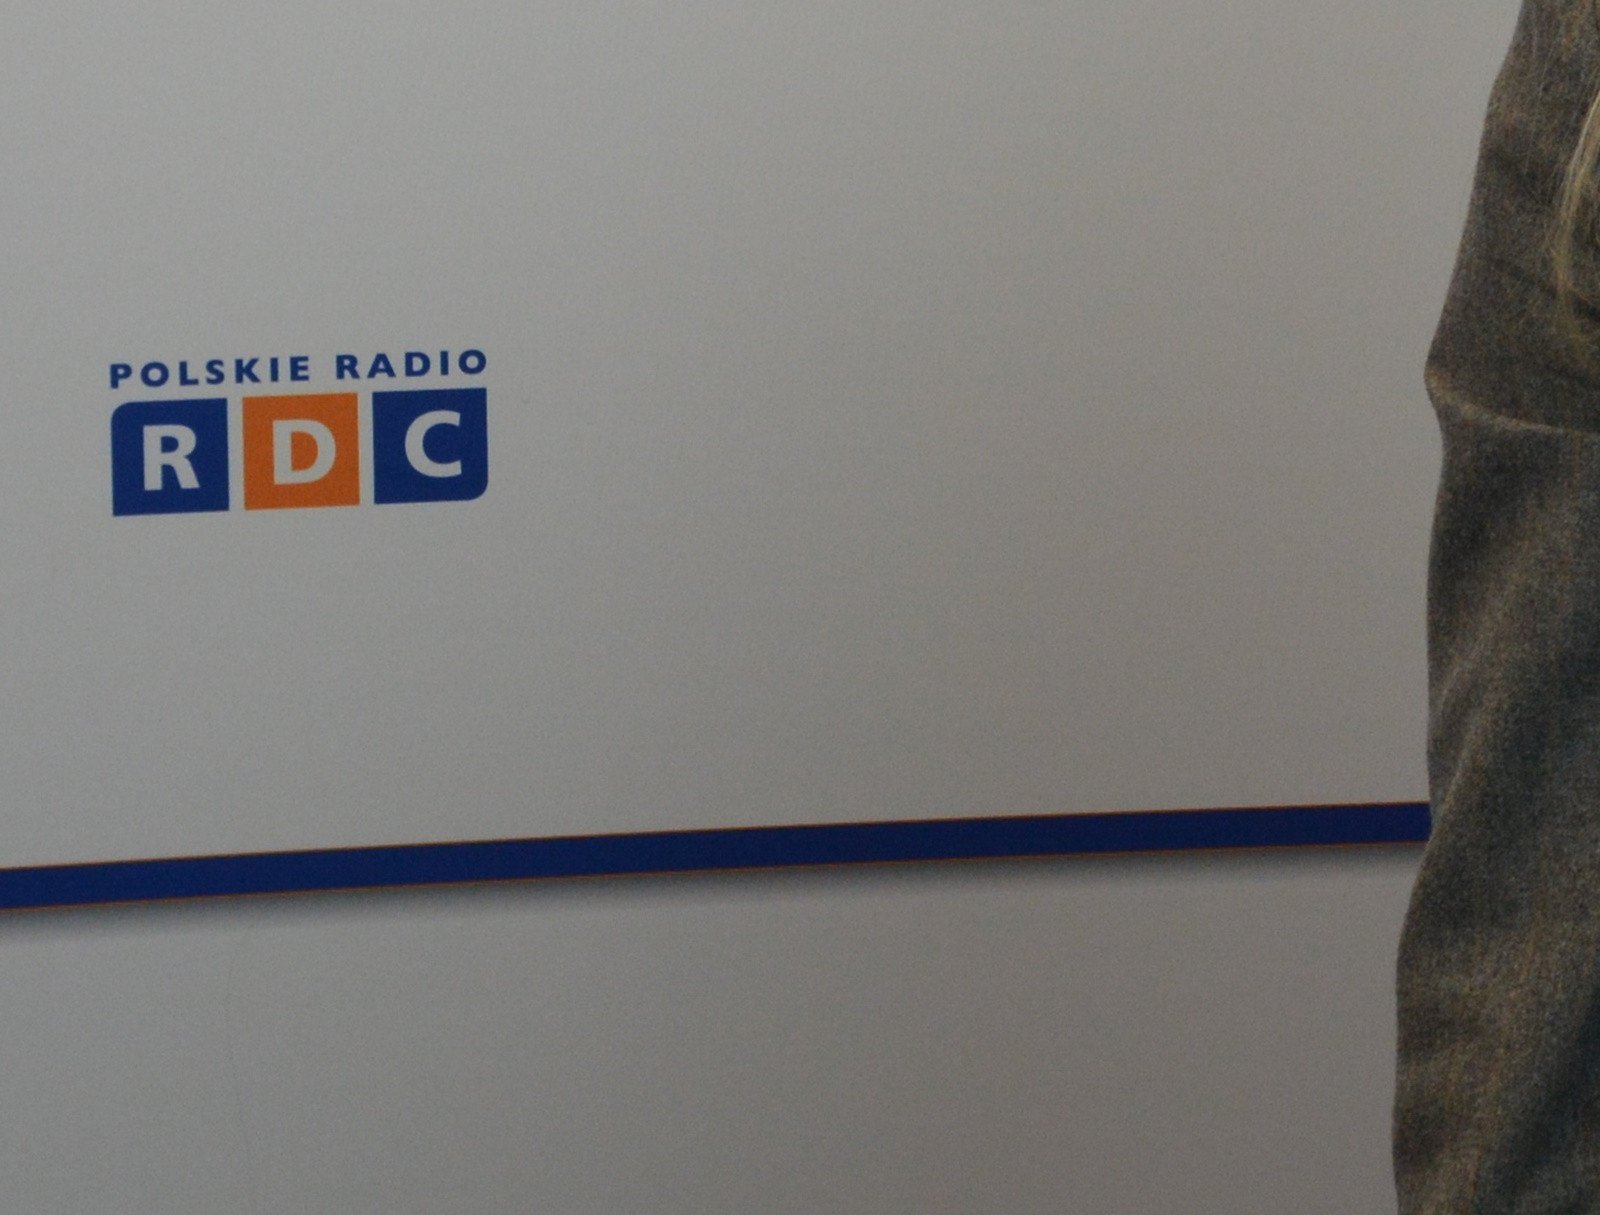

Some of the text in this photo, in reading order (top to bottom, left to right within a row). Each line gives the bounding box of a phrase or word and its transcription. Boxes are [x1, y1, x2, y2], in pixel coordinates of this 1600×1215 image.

[109, 348, 487, 390] POLSKIE RADIO
[144, 410, 461, 490] RDC
